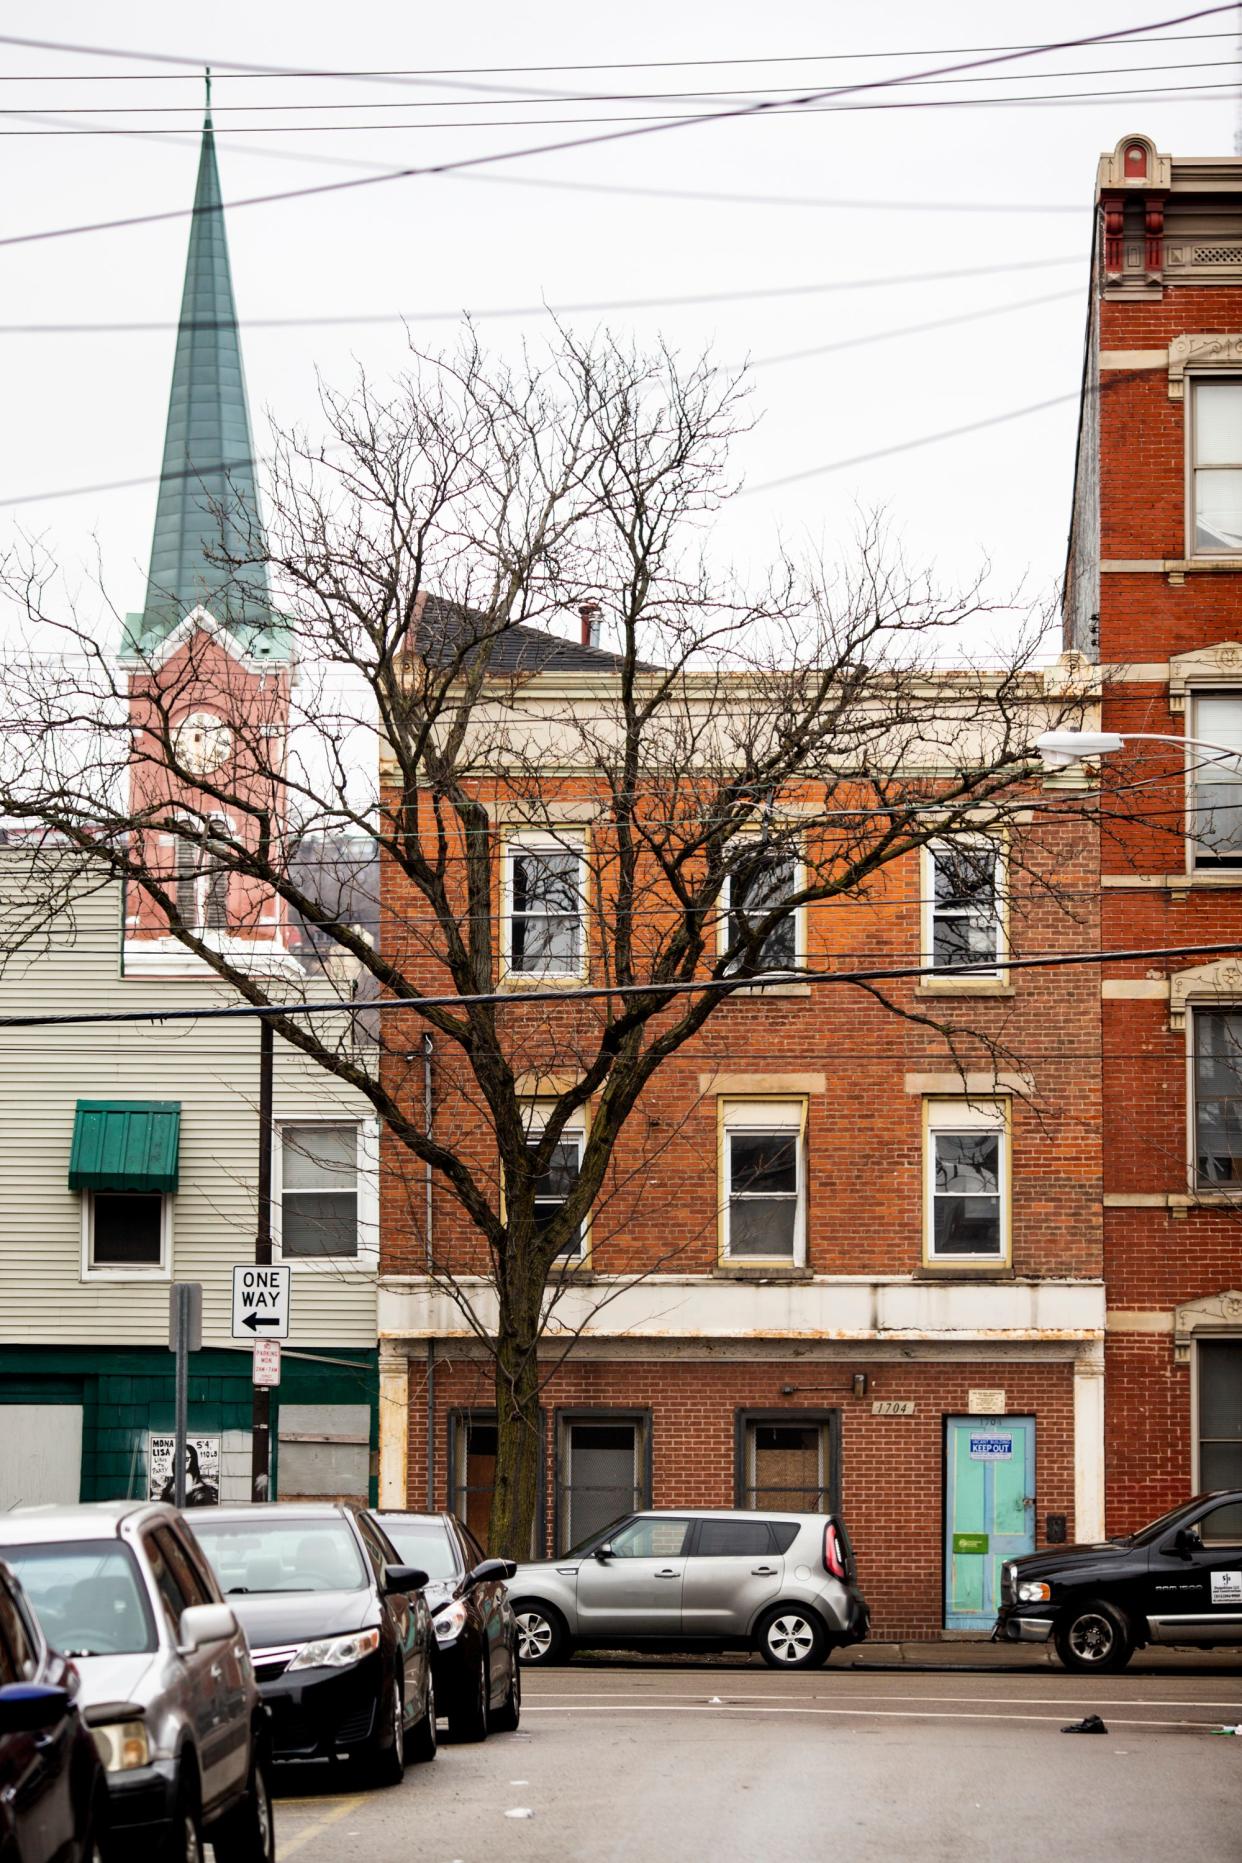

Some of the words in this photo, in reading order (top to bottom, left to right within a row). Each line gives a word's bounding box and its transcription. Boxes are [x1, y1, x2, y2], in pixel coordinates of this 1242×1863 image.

[243, 1272, 280, 1288] ONE
[242, 1291, 280, 1307] WAY
[878, 1402, 907, 1414] 1704
[972, 1444, 992, 1452] KEEP
[993, 1444, 1009, 1452] OUT
[152, 1466, 168, 1474] PARTY
